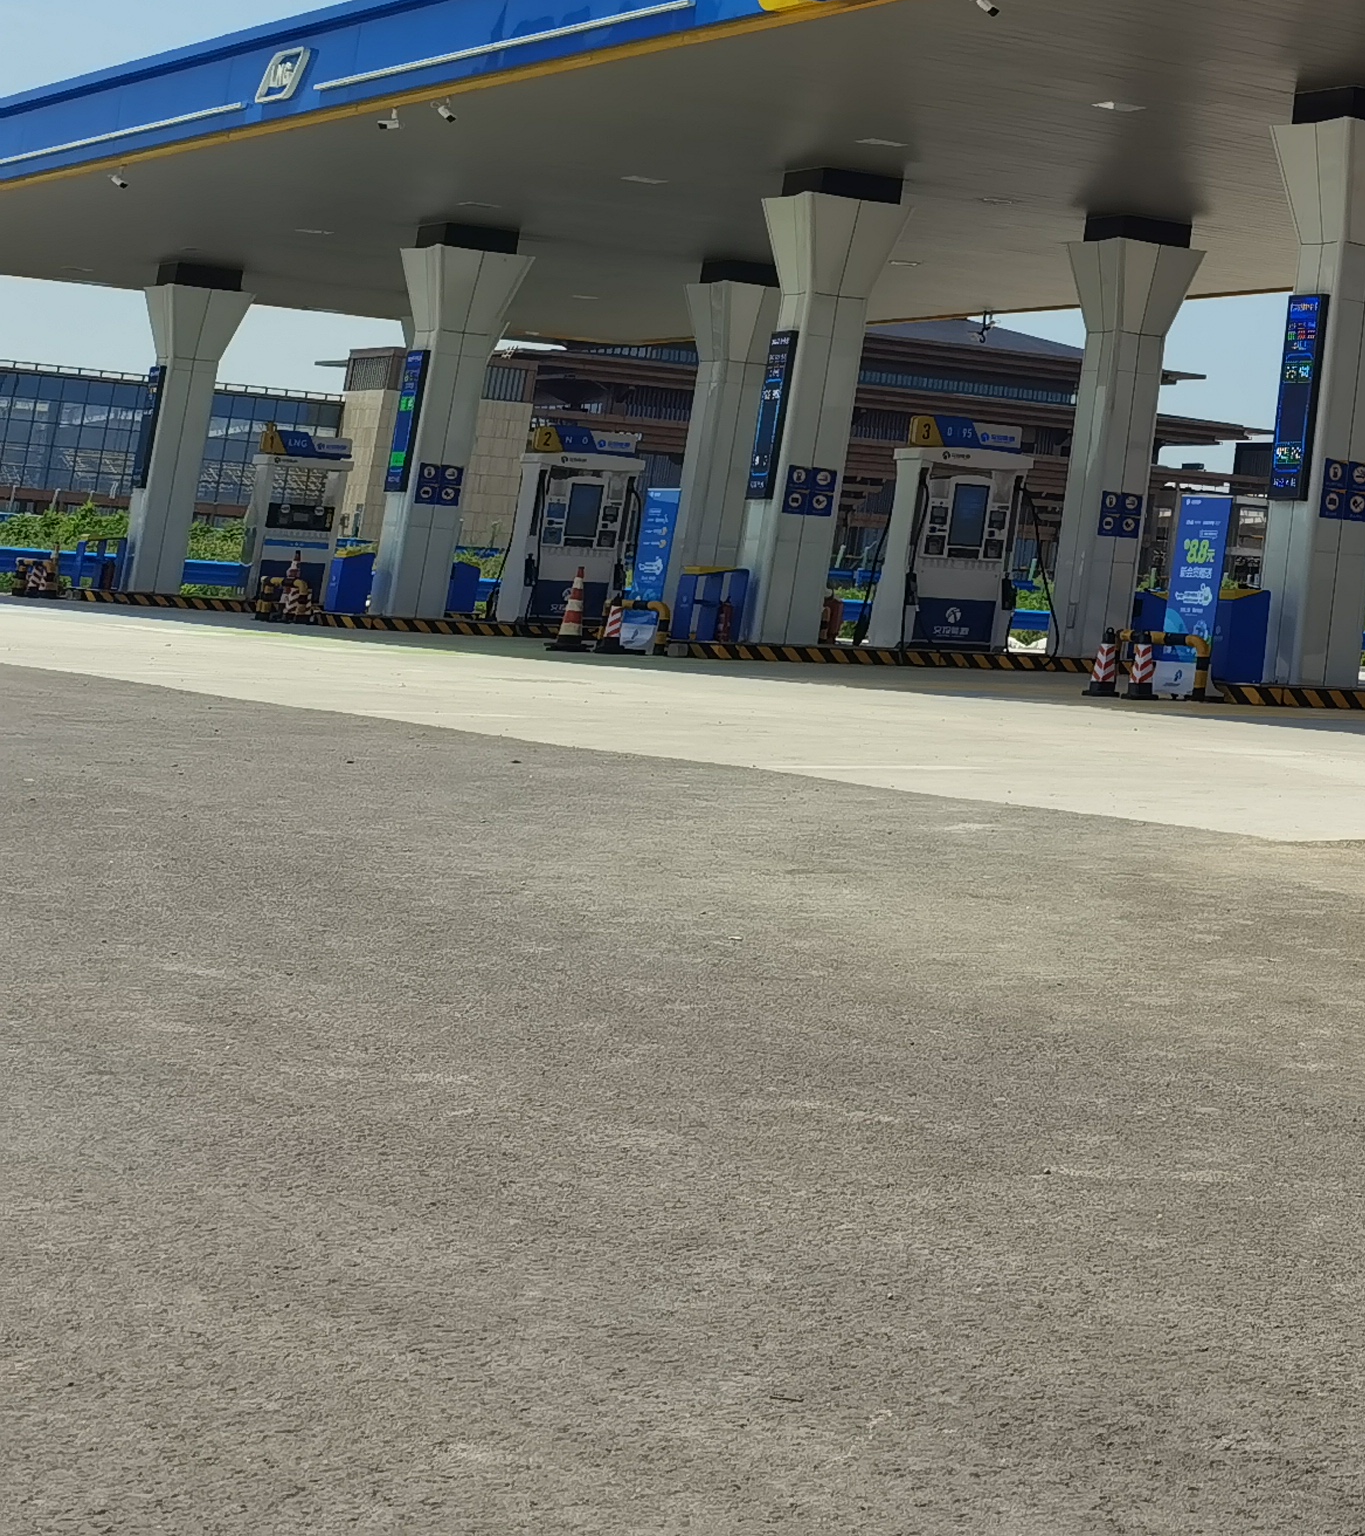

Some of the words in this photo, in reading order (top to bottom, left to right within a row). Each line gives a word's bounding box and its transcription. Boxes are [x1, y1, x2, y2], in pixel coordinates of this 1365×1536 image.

[268, 61, 294, 89] LNG
[543, 431, 553, 447] 2
[922, 423, 931, 440] 3
[287, 438, 309, 448] LNG
